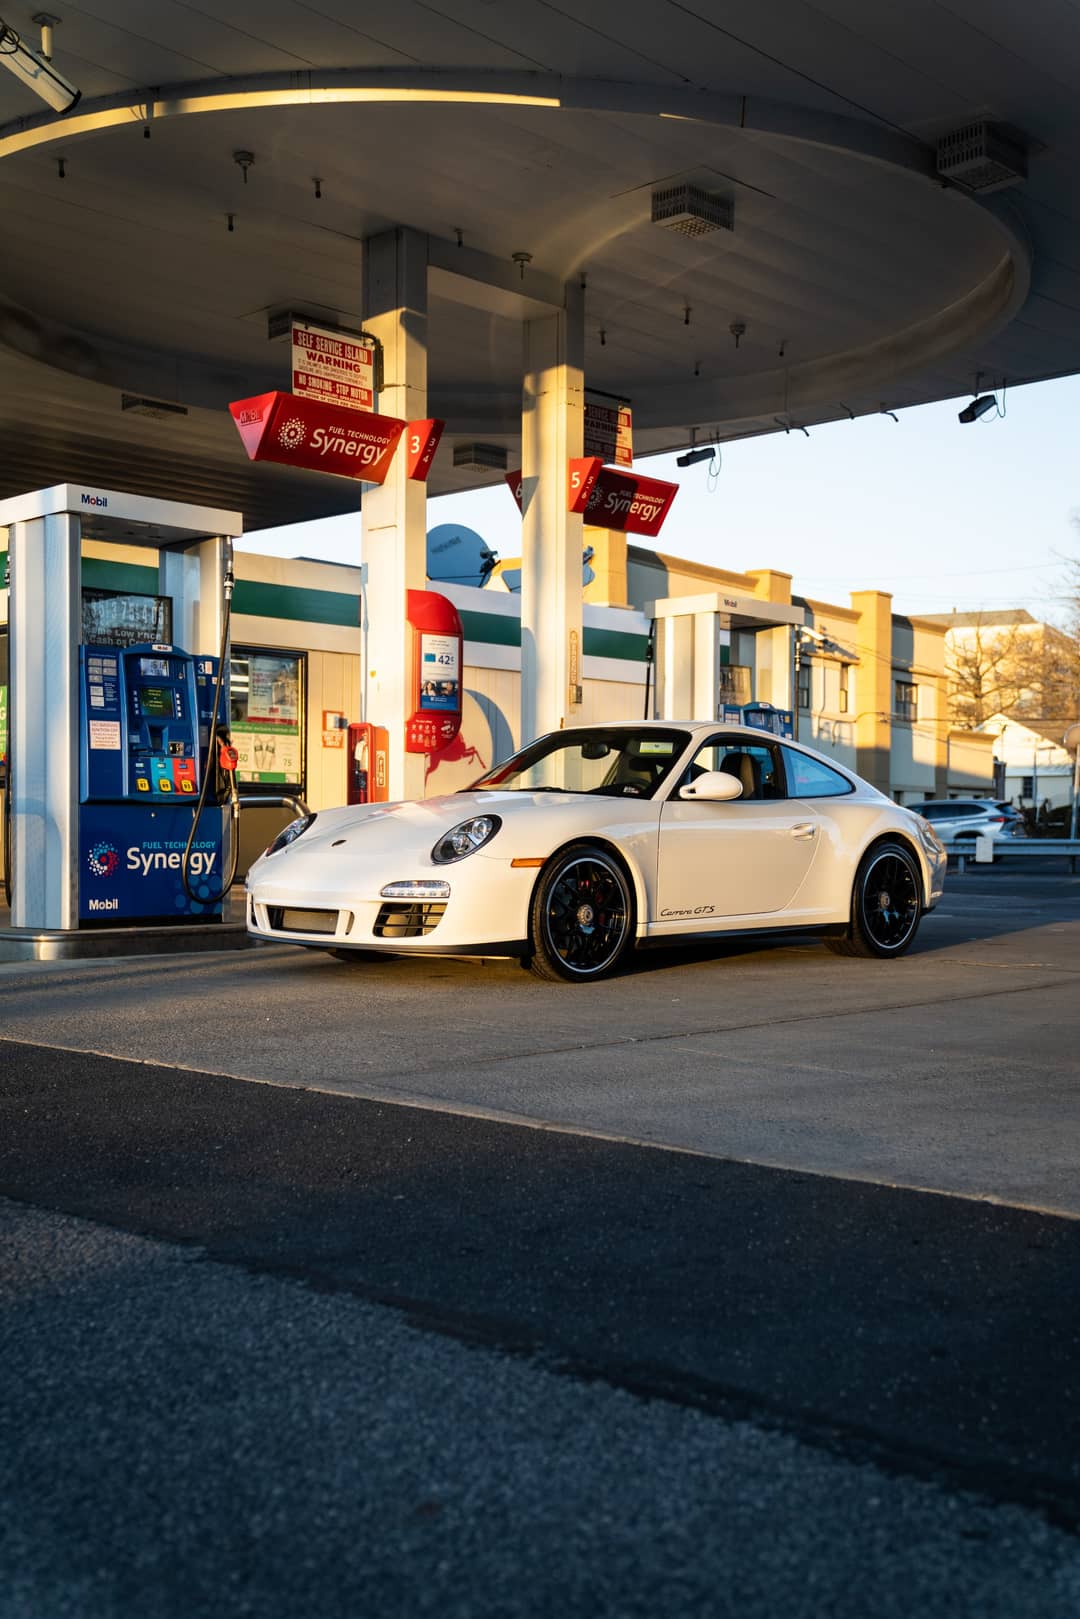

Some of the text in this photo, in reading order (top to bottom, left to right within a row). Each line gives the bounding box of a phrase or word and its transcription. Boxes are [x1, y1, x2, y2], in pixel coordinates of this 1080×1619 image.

[297, 332, 368, 363] SELF SERVICE ISLAND
[306, 350, 361, 373] WARNING
[308, 376, 332, 391] SMOKING
[328, 426, 391, 444] FUEL TECHNOLOGY
[310, 428, 387, 466] Synergy
[411, 435, 420, 454] 3
[571, 471, 580, 489] 5
[81, 493, 108, 507] Mobil
[604, 492, 661, 522] Synergy
[633, 492, 666, 504] TECHNOLOGY
[143, 841, 216, 849] FUEL TECHOLOGY
[88, 899, 118, 911] Mobil
[660, 905, 716, 917] Carrera GTS
